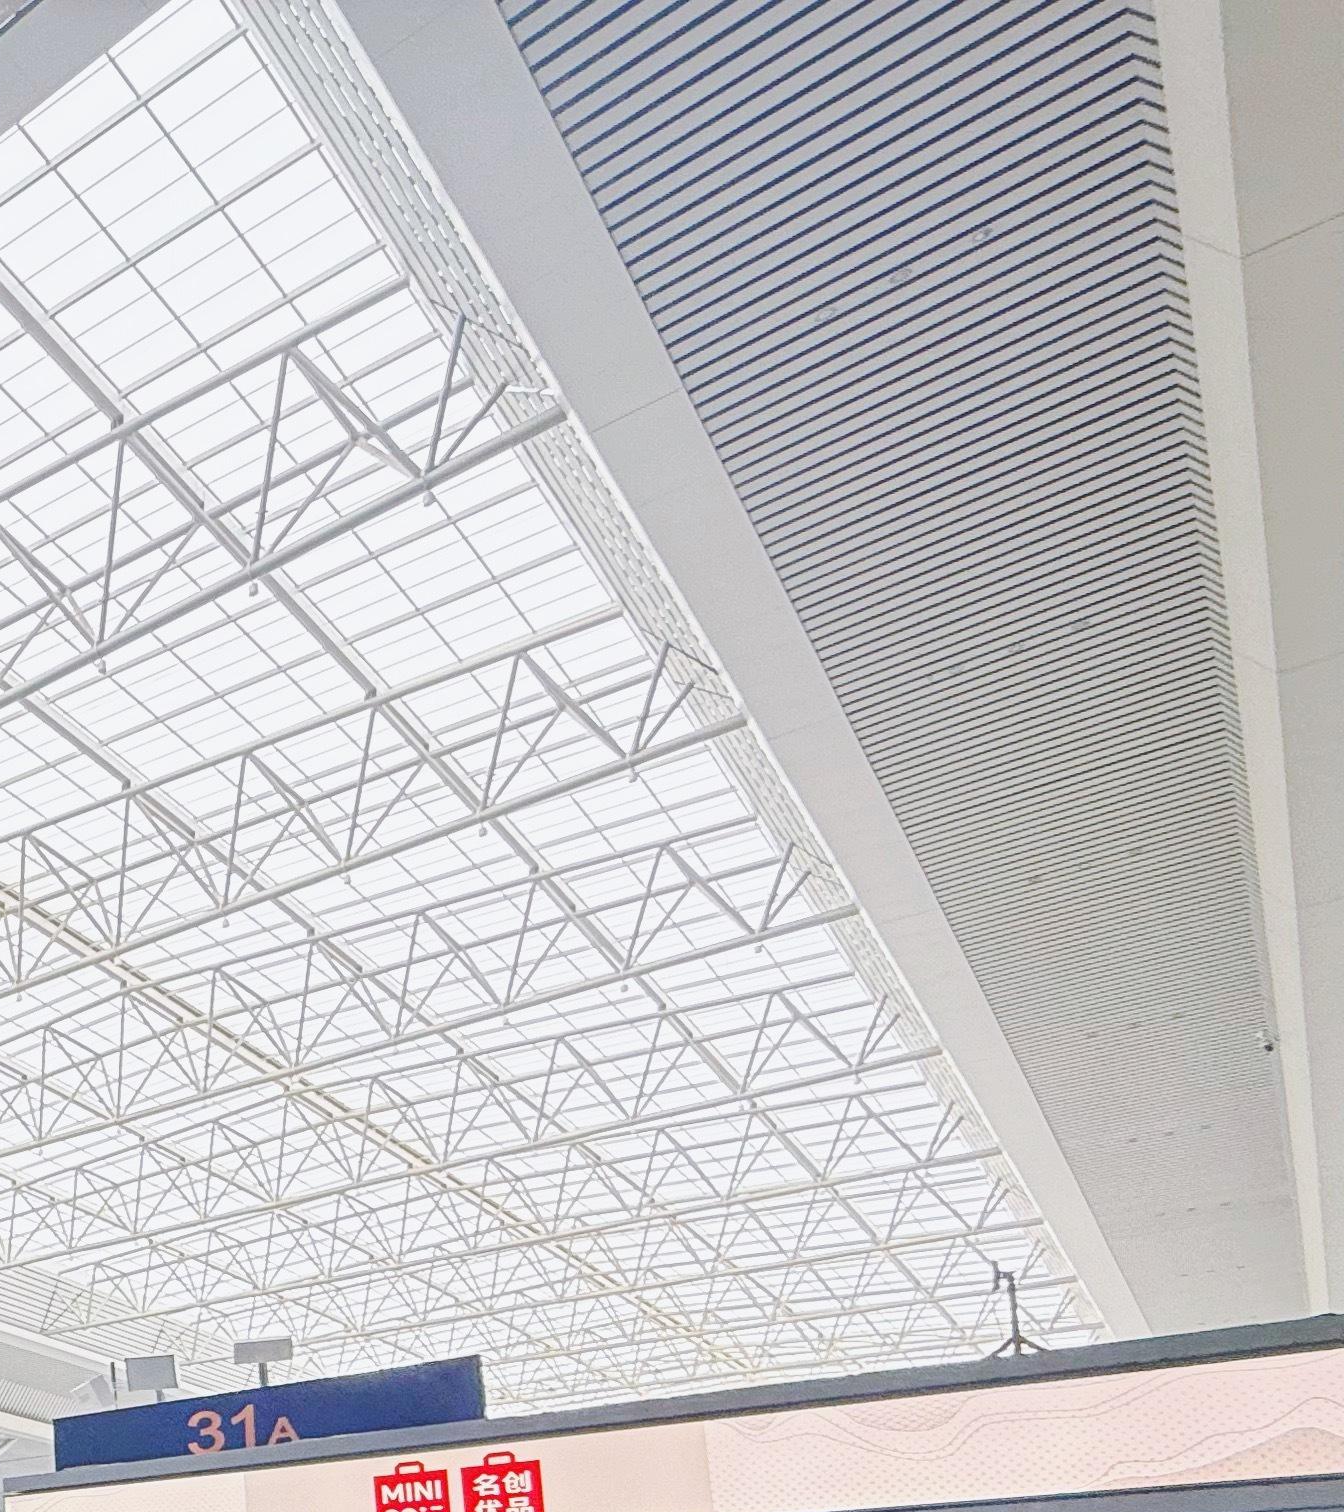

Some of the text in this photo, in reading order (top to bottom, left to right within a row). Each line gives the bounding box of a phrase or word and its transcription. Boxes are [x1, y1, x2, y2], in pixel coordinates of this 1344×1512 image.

[186, 1403, 301, 1457] 31A
[380, 1479, 443, 1505] MINI
[472, 1469, 533, 1497] 名创
